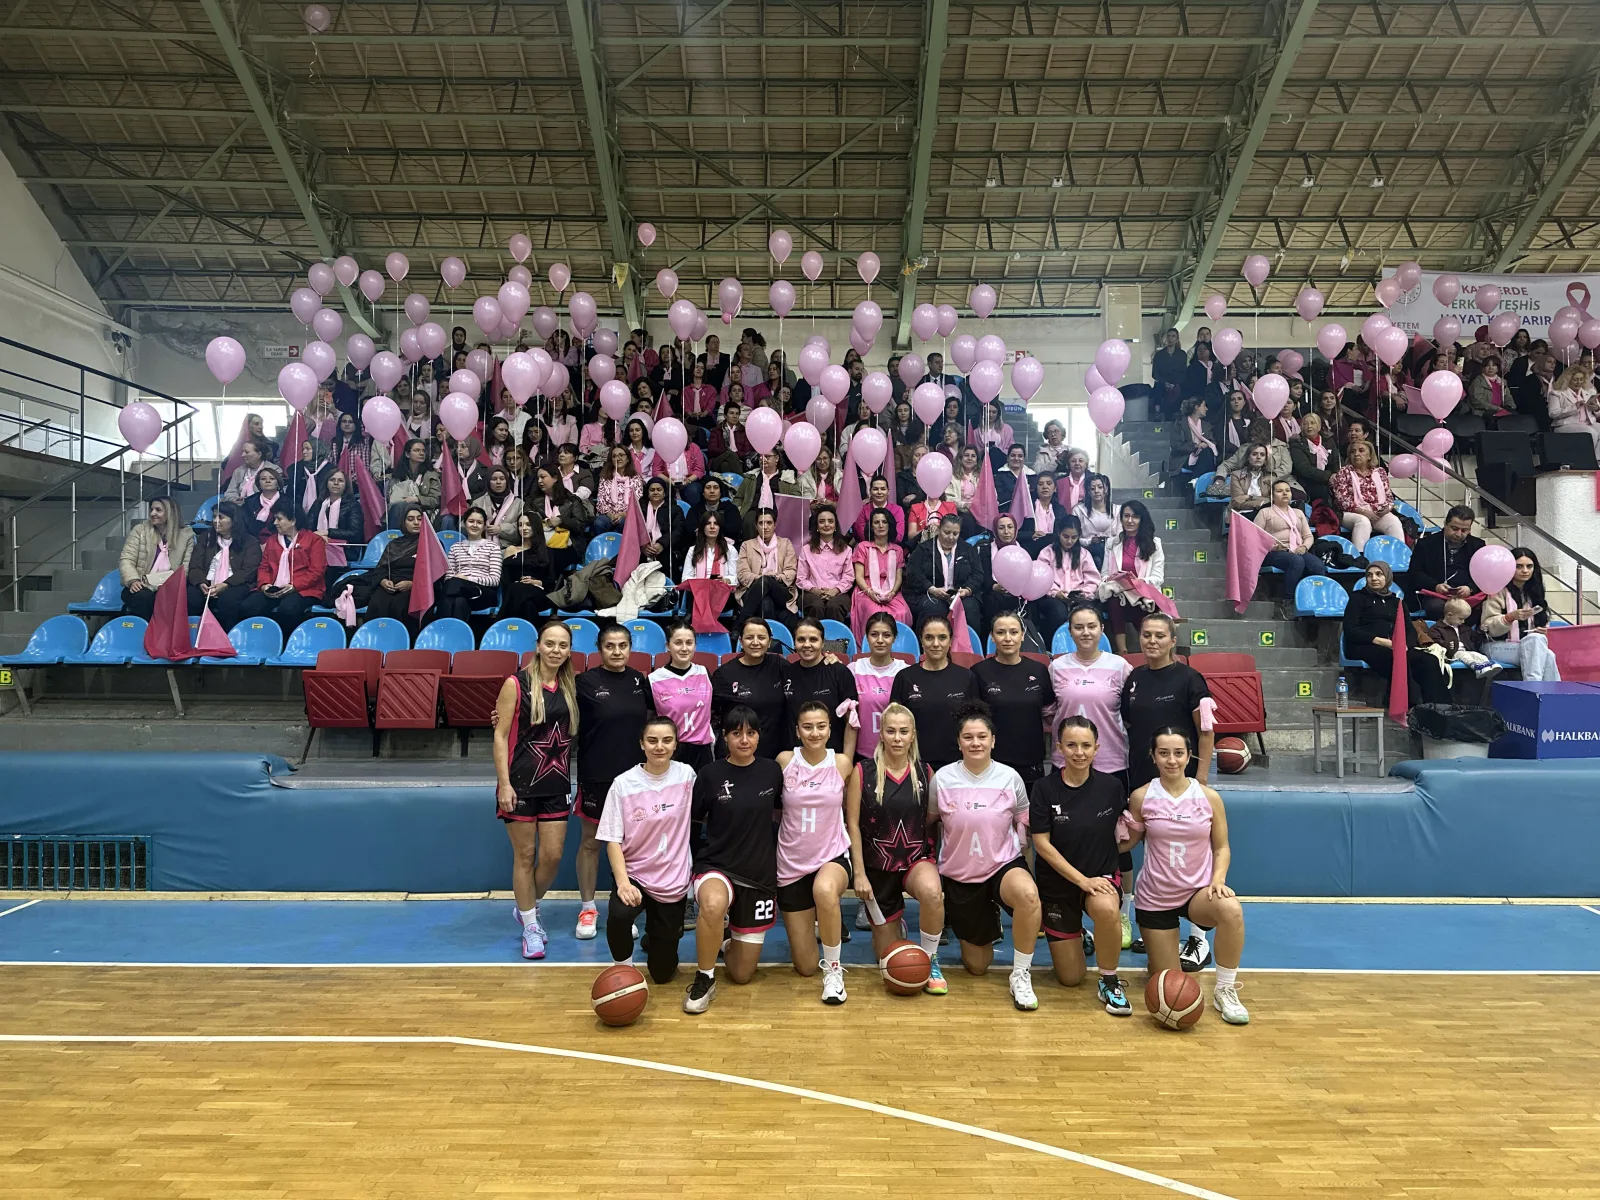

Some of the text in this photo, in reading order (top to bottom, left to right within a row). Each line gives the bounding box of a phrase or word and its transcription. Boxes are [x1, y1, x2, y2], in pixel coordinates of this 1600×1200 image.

[1461, 285, 1529, 296] KAERDE
[1499, 298, 1541, 312] TEŞHİS
[1391, 321, 1420, 330] KETEM
[1487, 315, 1552, 326] KARIR
[1143, 490, 1153, 499] G
[1168, 520, 1177, 530] F
[1196, 552, 1206, 562] E
[1193, 632, 1206, 644] C
[1261, 632, 1273, 644] C
[0, 671, 12, 683] B
[1299, 684, 1311, 695] B
[683, 712, 697, 732] K
[1505, 721, 1536, 739] ALKBANK
[1555, 731, 1600, 741] HALKBA
[801, 807, 816, 833] H
[970, 832, 984, 858] A
[1169, 841, 1187, 869] R
[754, 899, 774, 920] 22
